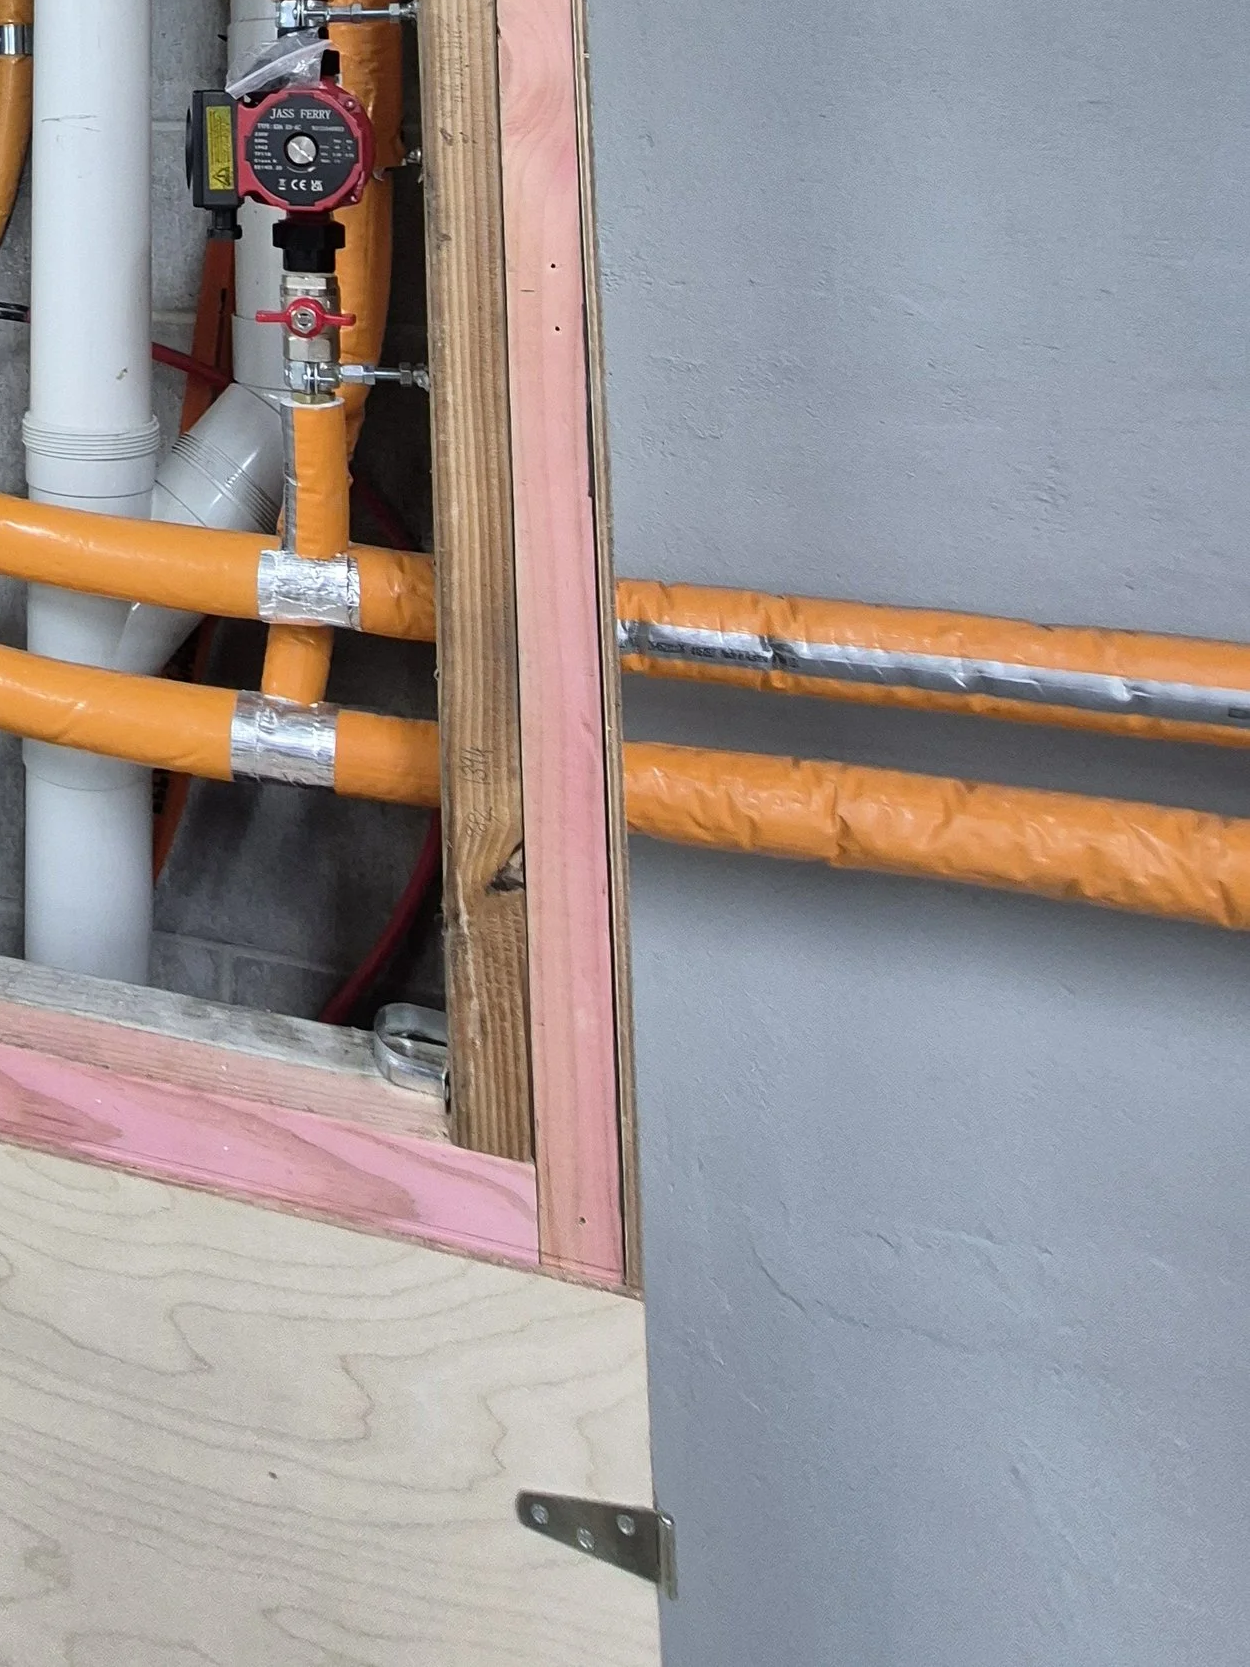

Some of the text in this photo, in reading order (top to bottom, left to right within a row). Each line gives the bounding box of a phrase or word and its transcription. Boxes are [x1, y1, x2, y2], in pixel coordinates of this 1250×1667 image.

[269, 108, 332, 120] JASS FERRY
[290, 178, 307, 191] CE
